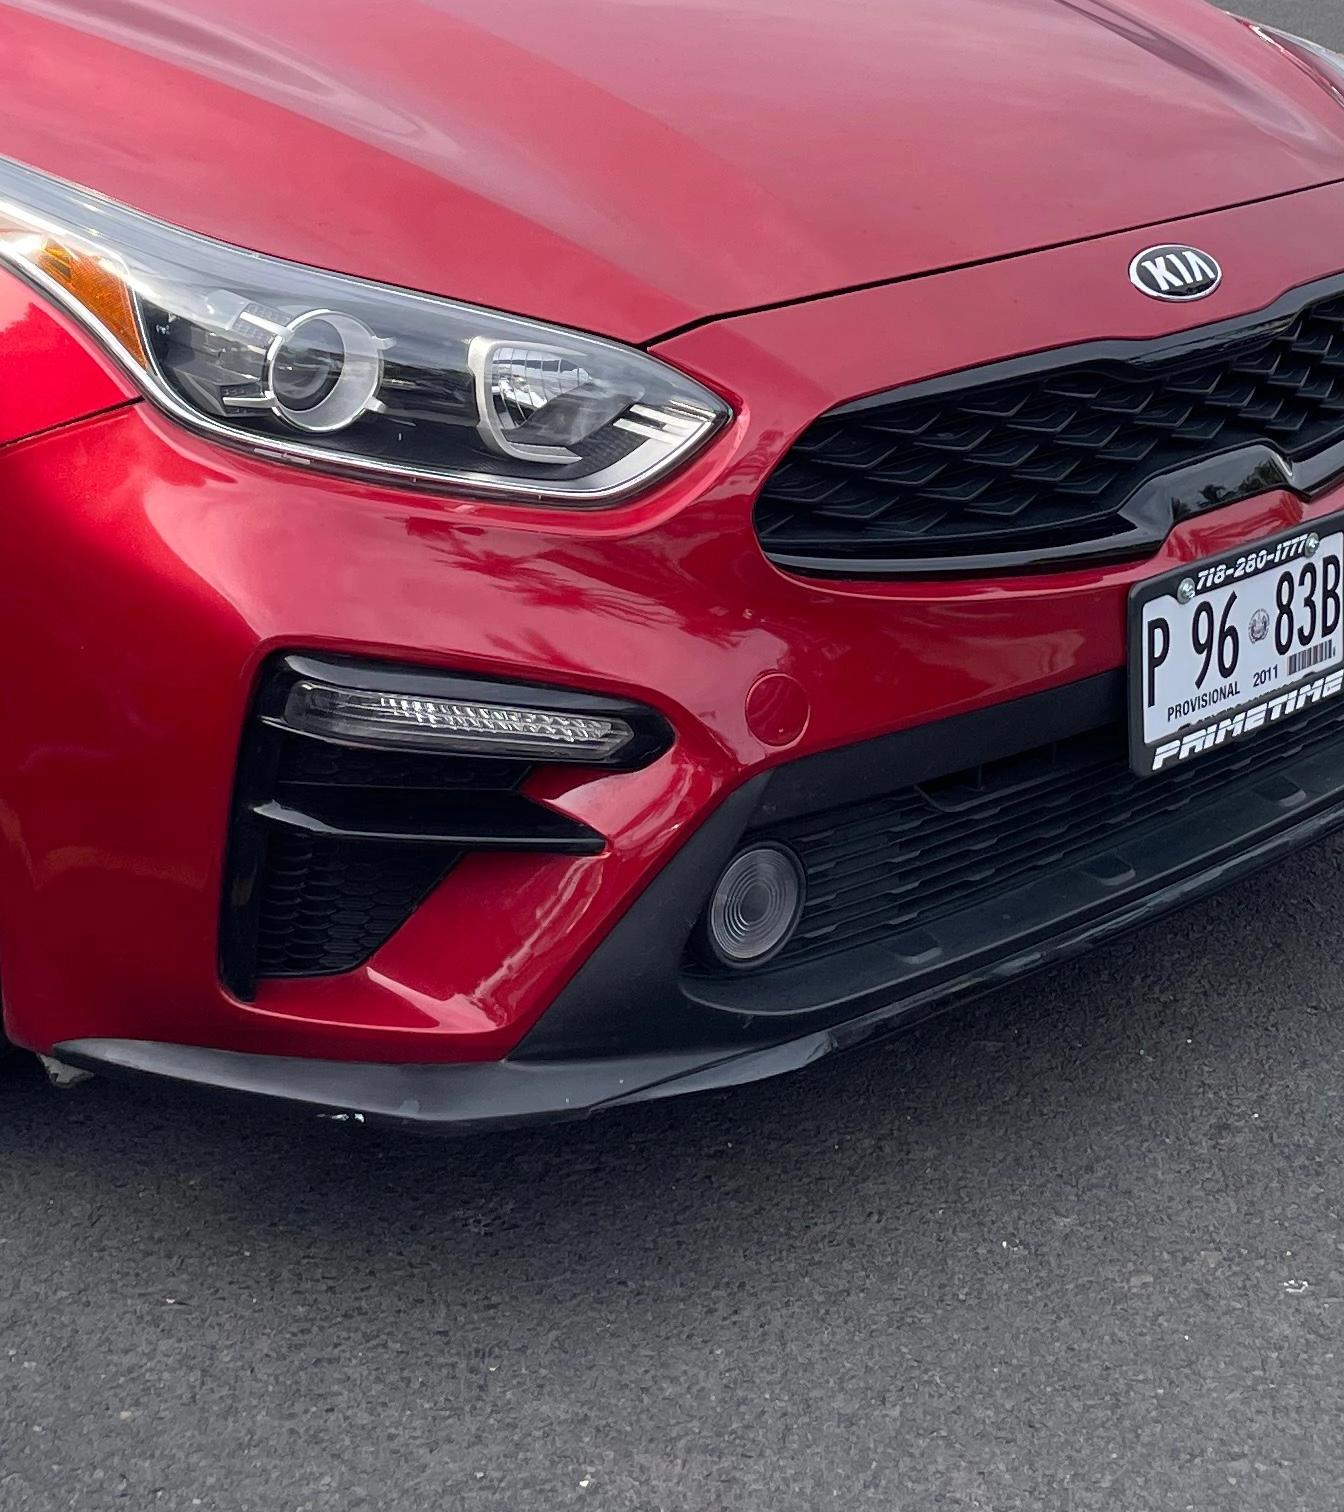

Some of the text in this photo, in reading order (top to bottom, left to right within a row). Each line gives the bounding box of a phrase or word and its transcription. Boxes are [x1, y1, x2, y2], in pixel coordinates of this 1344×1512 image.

[1141, 250, 1216, 291] KIA
[1147, 554, 1341, 708] P 96 83B
[1152, 668, 1344, 771] PRIMETIME
[1167, 664, 1278, 722] PROVISIONAL 2011
